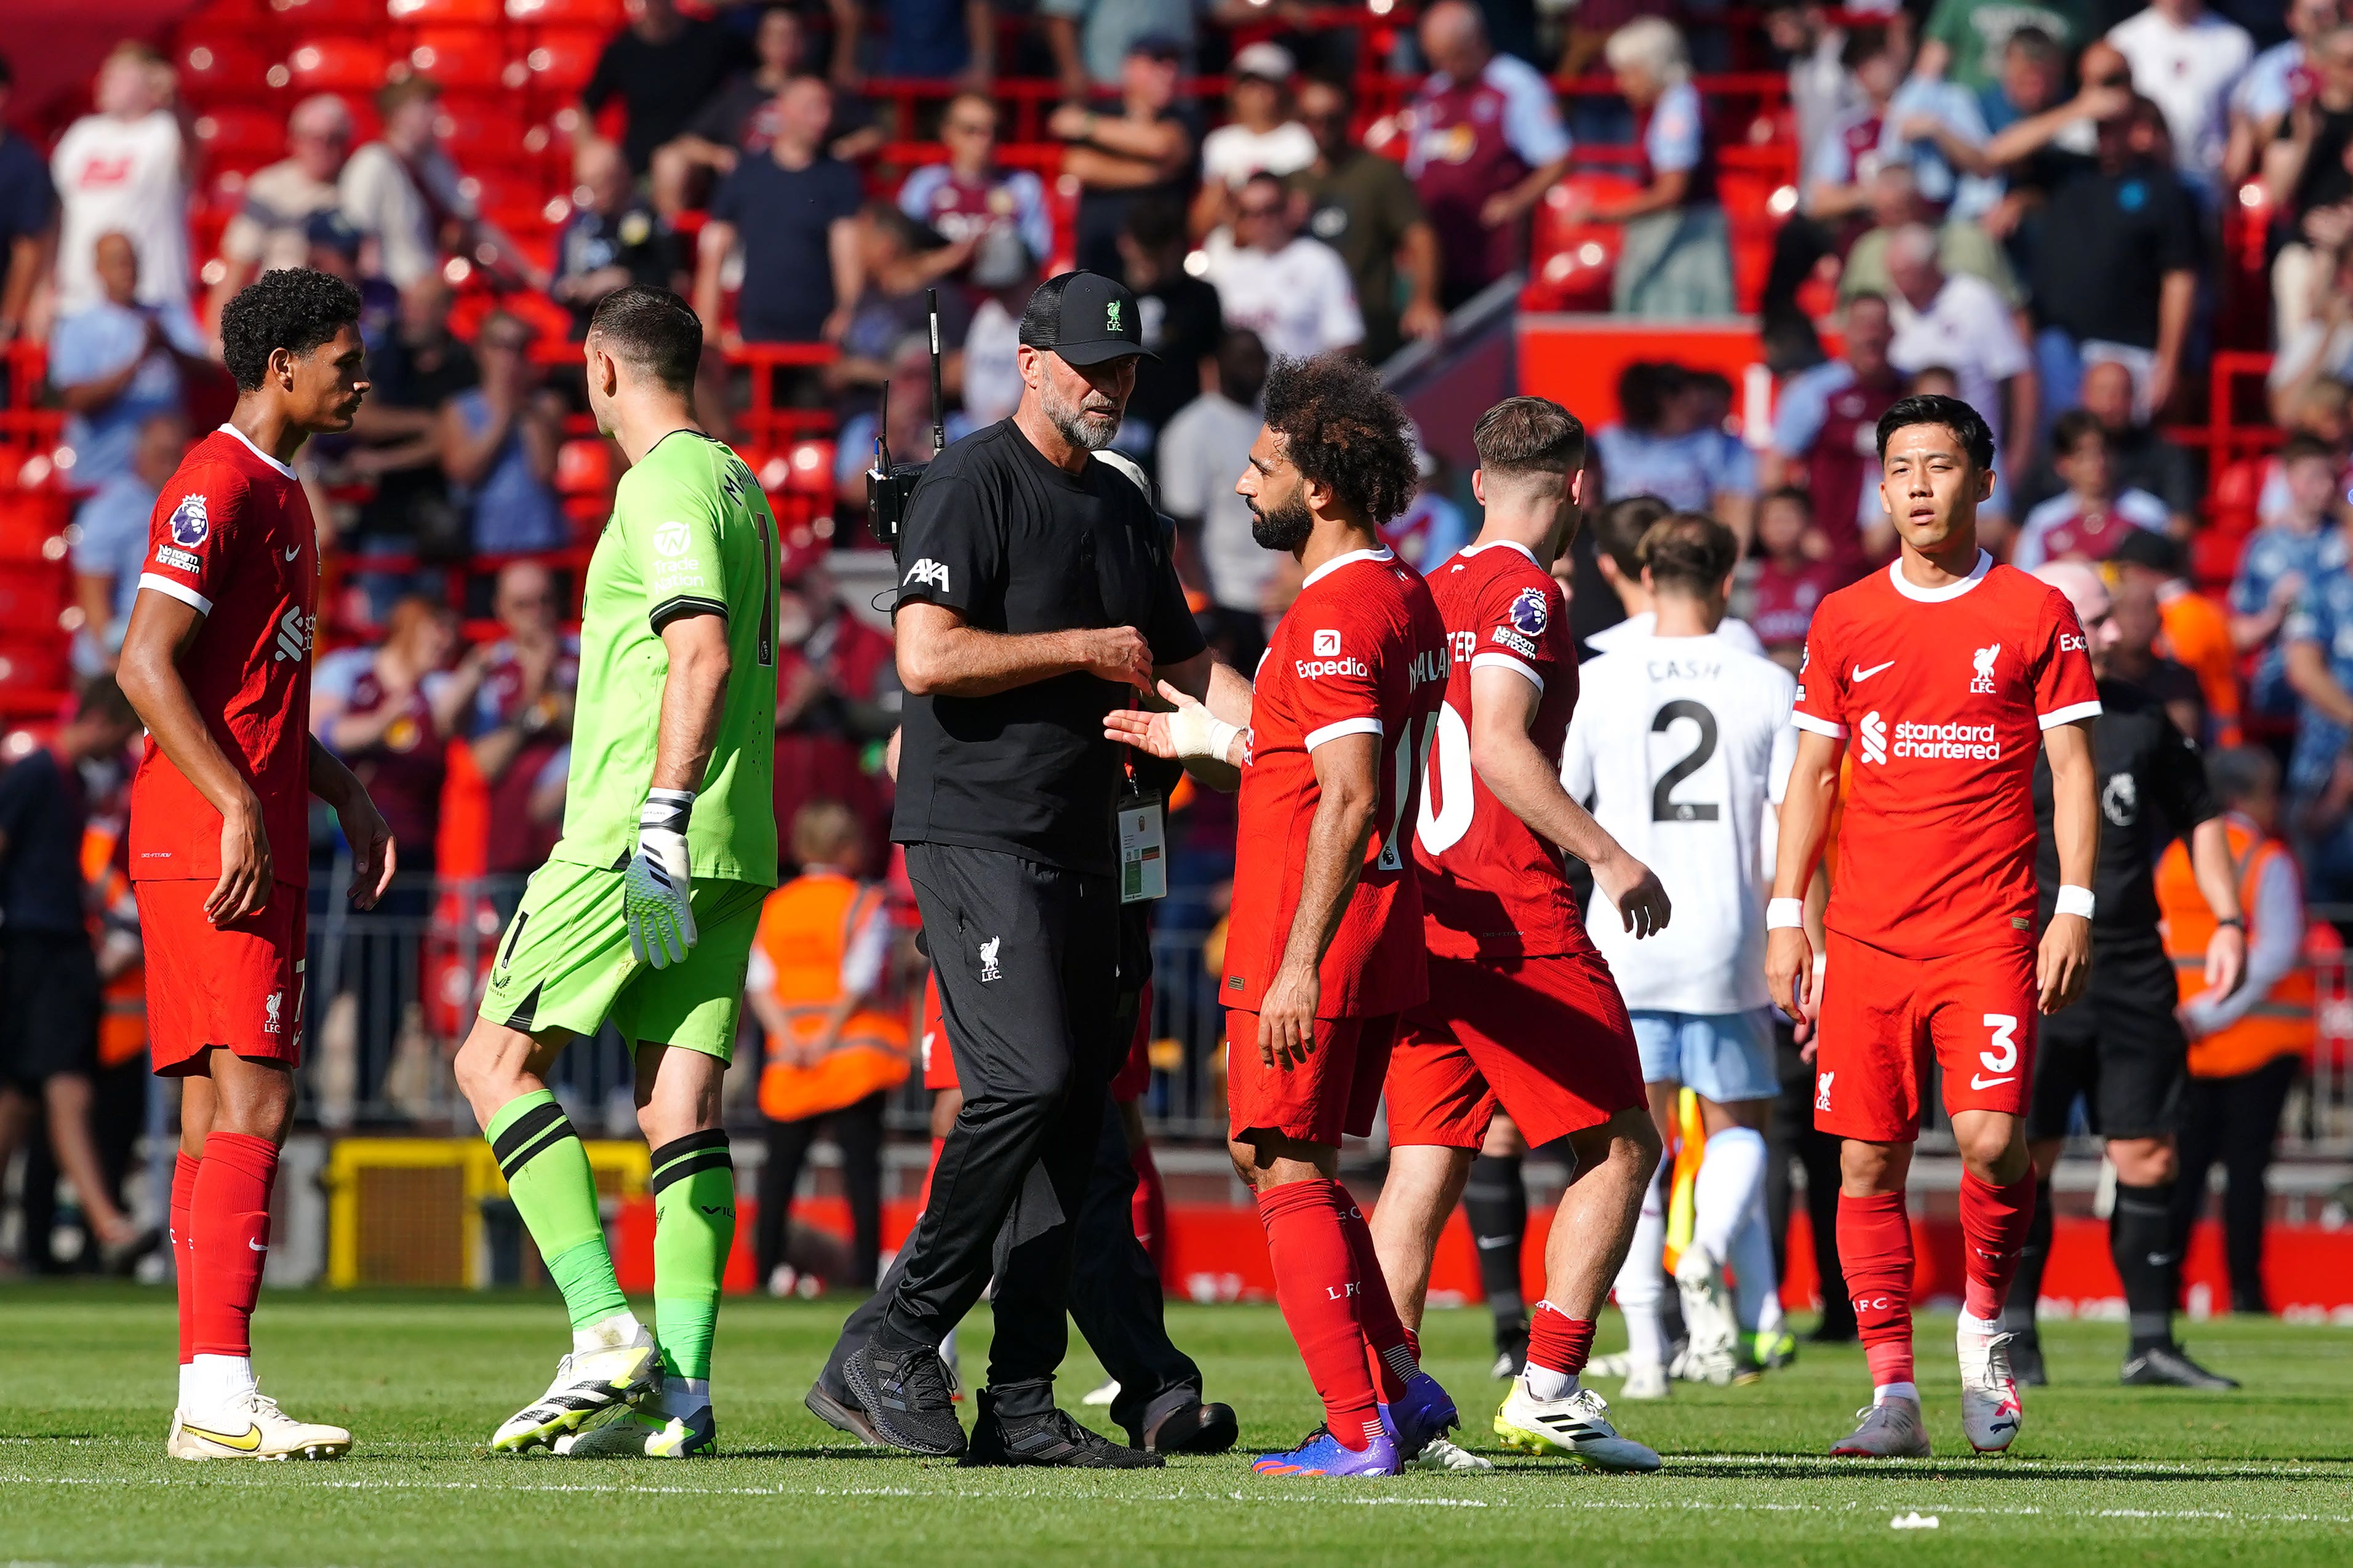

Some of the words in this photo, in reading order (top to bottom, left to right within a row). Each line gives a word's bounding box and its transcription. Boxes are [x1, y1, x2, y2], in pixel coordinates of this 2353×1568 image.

[155, 554, 171, 563] for
[168, 557, 200, 574] racism
[158, 544, 172, 556] No
[172, 549, 198, 565] room
[653, 557, 699, 575] Trade
[654, 573, 705, 594] Nation
[901, 558, 949, 593] AXA
[756, 511, 772, 666] 1
[1492, 635, 1508, 645] for
[1506, 639, 1536, 659] racism
[1495, 625, 1511, 639] No
[1510, 632, 1535, 652] room
[1295, 656, 1367, 680] Expedia
[1647, 660, 1721, 683] CASH
[1895, 720, 1995, 743] standard
[1652, 699, 1719, 822] 2
[1893, 739, 2000, 761] chartered
[501, 910, 529, 969] 1
[1979, 1013, 2018, 1073] 3
